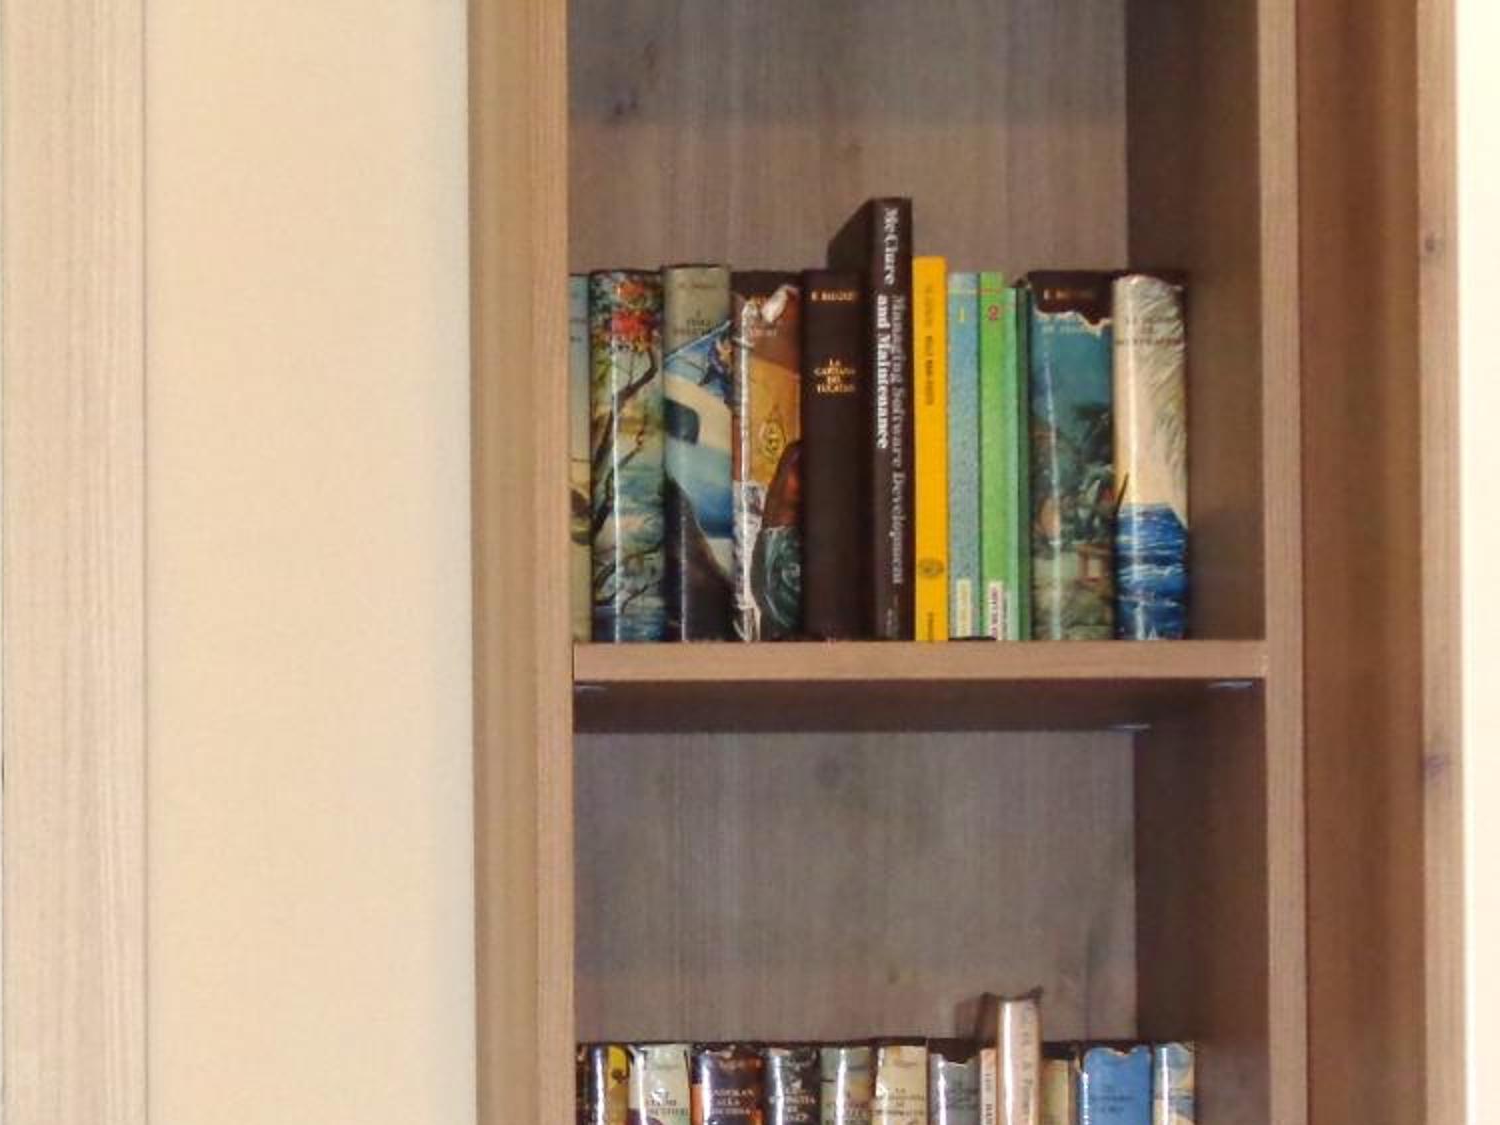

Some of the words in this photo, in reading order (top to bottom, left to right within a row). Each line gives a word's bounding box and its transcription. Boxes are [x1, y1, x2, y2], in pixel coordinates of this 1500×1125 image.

[877, 294, 892, 329] and
[891, 294, 906, 385] Managing
[877, 332, 892, 449] Maintenance
[891, 387, 906, 468] Software
[889, 471, 907, 585] Development
